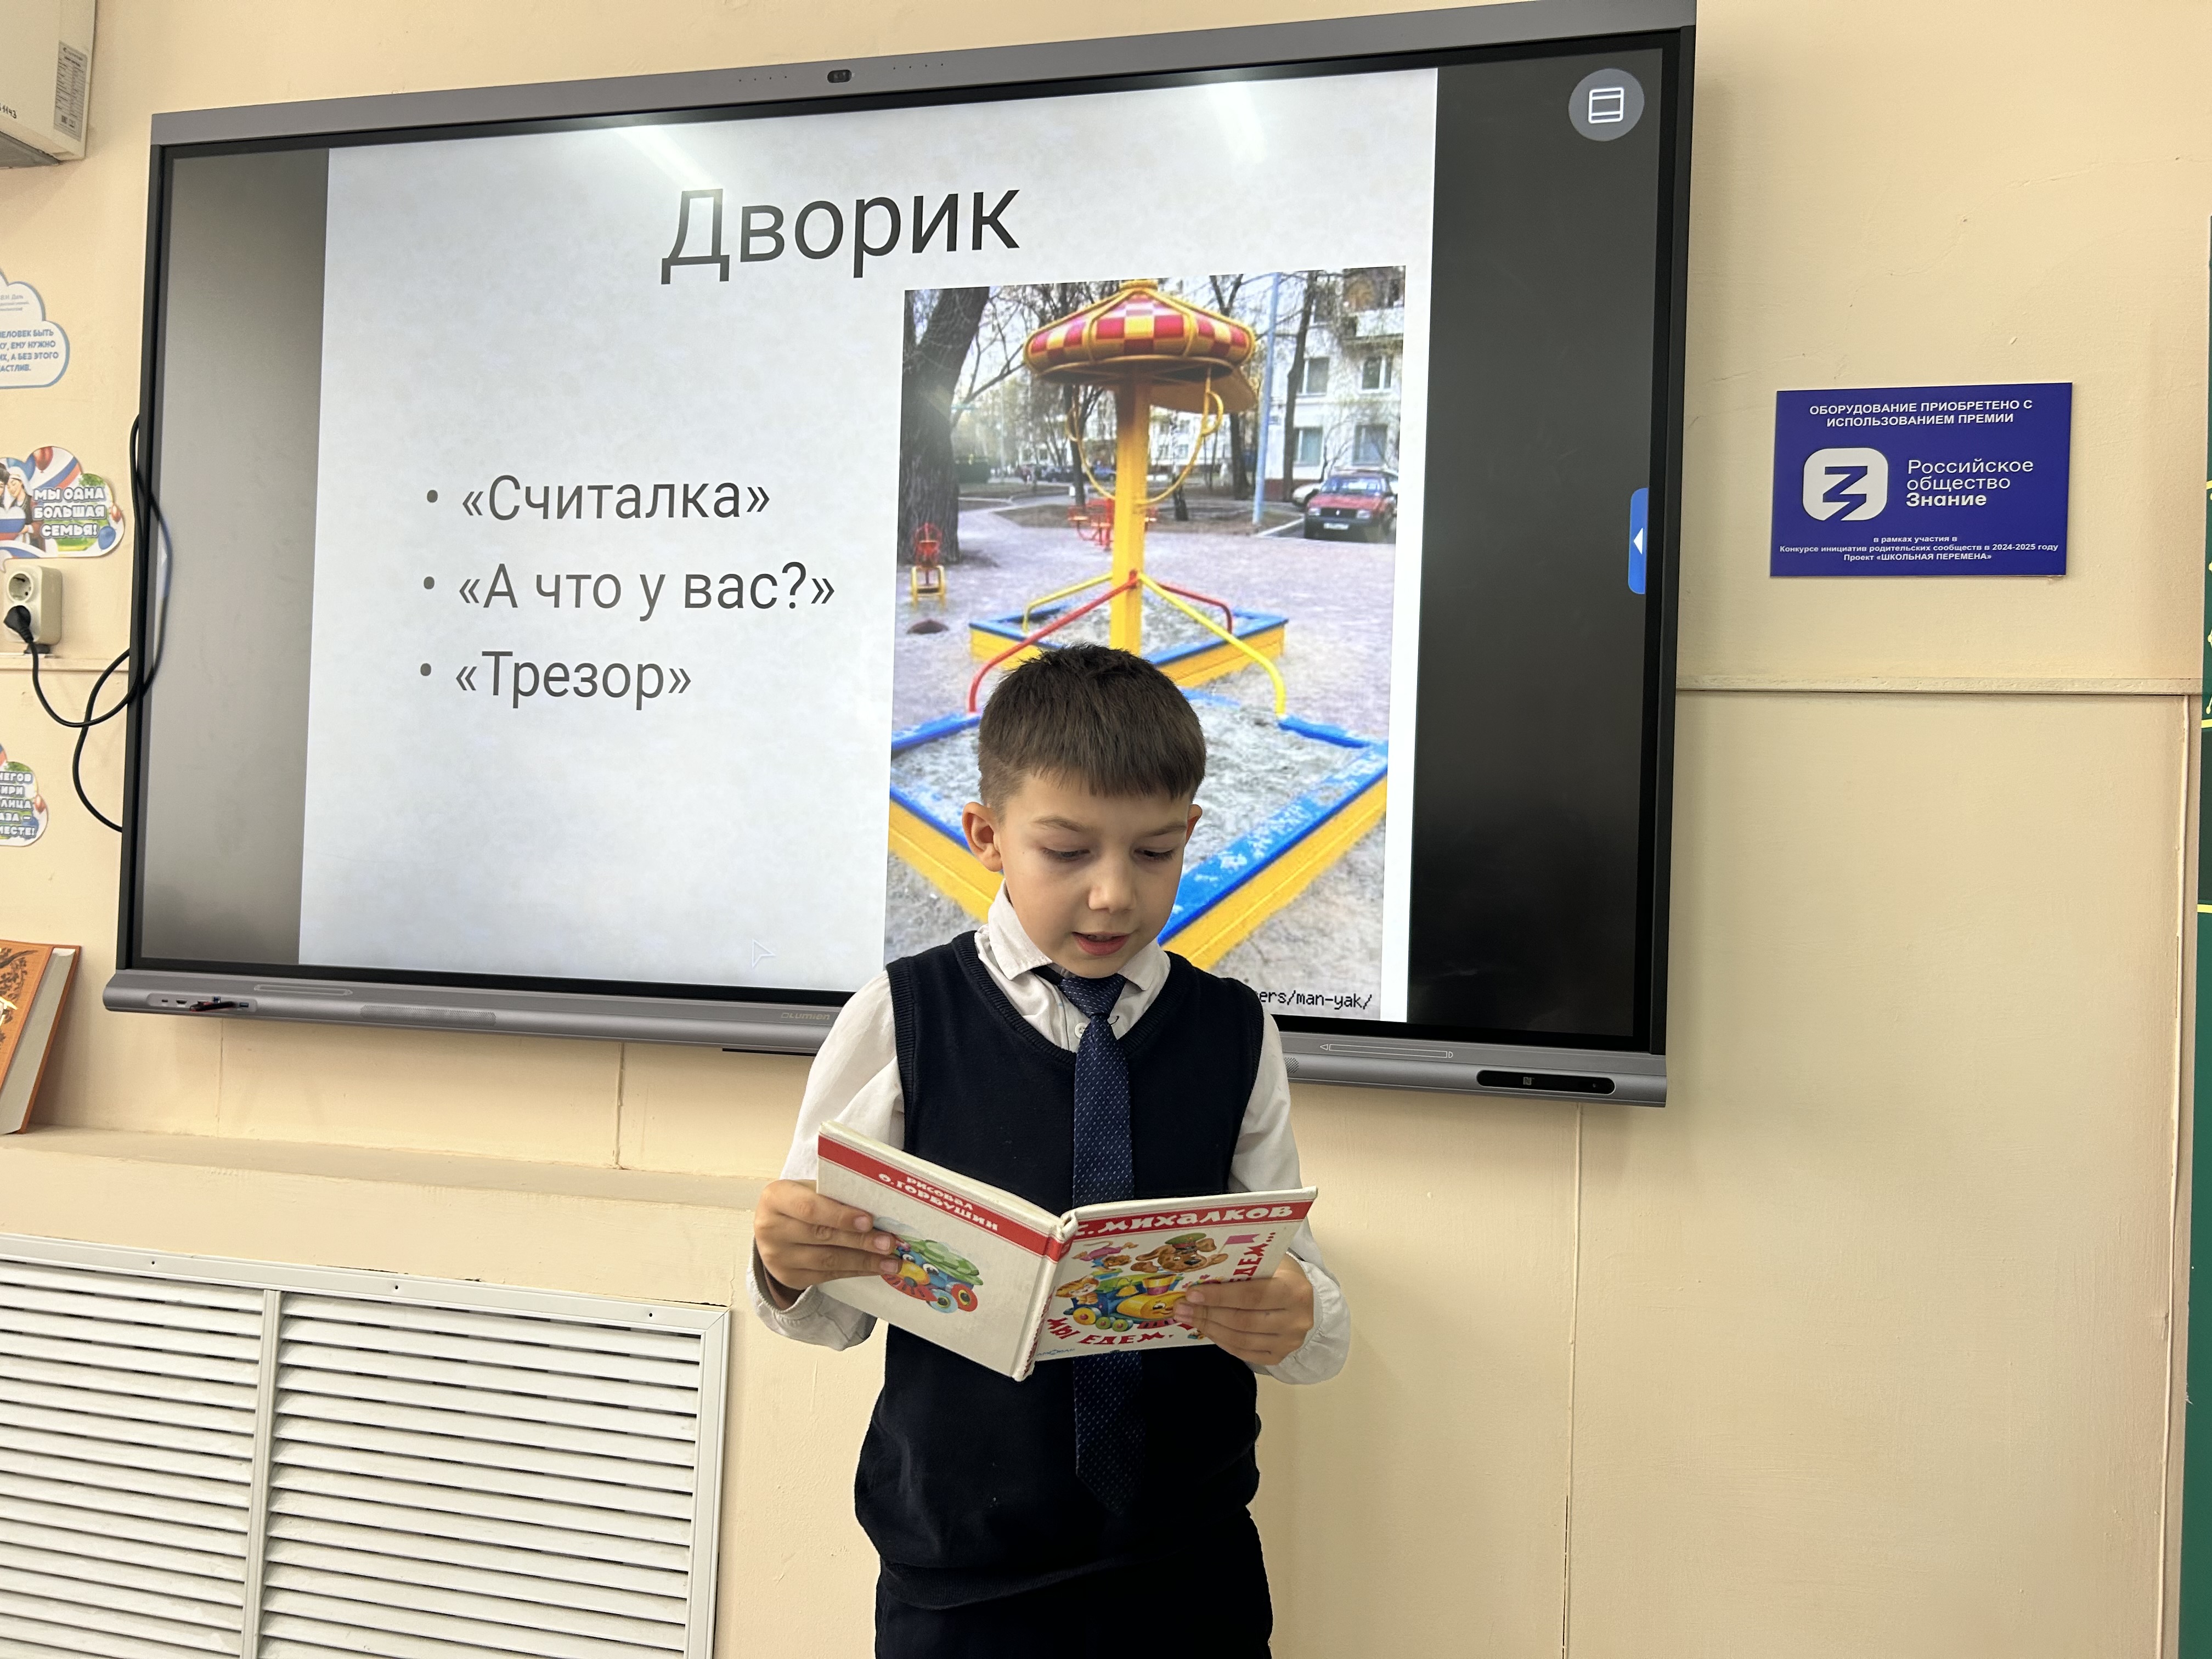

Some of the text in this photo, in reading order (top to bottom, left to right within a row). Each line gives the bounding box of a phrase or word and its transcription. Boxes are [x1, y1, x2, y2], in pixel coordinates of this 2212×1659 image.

[661, 188, 1020, 285] Дворик
[0, 330, 31, 338] ЕЛОВЕК
[28, 340, 56, 348] НУЖНО
[1809, 400, 2033, 415] ОБОРУДОВАНИЕ ПРИОБРЕТЕНО С
[1827, 413, 2014, 427] ИСПОЛЬЗОВАНИЕМ ПРЕМИИ
[1908, 458, 2034, 475] Российское
[1906, 476, 2011, 492] общество
[33, 487, 105, 501] МЫ ОДНА
[462, 475, 770, 521] «Считалка»
[1906, 492, 1987, 507] Знание
[33, 505, 105, 519] БОЛЬШАЯ
[41, 524, 98, 536] СЕМЬЯ!
[1779, 545, 1819, 554] Конкурсе
[1843, 554, 1875, 562] Проект
[459, 561, 835, 622] «А что у вас?»
[456, 650, 691, 711] «Трезор»
[1255, 990, 1373, 1011] ers/man-yak/
[878, 1173, 998, 1232] О. ГОРБУШИН
[1229, 1232, 1276, 1282] ДЕМ...
[1047, 1317, 1081, 1340] МЫ
